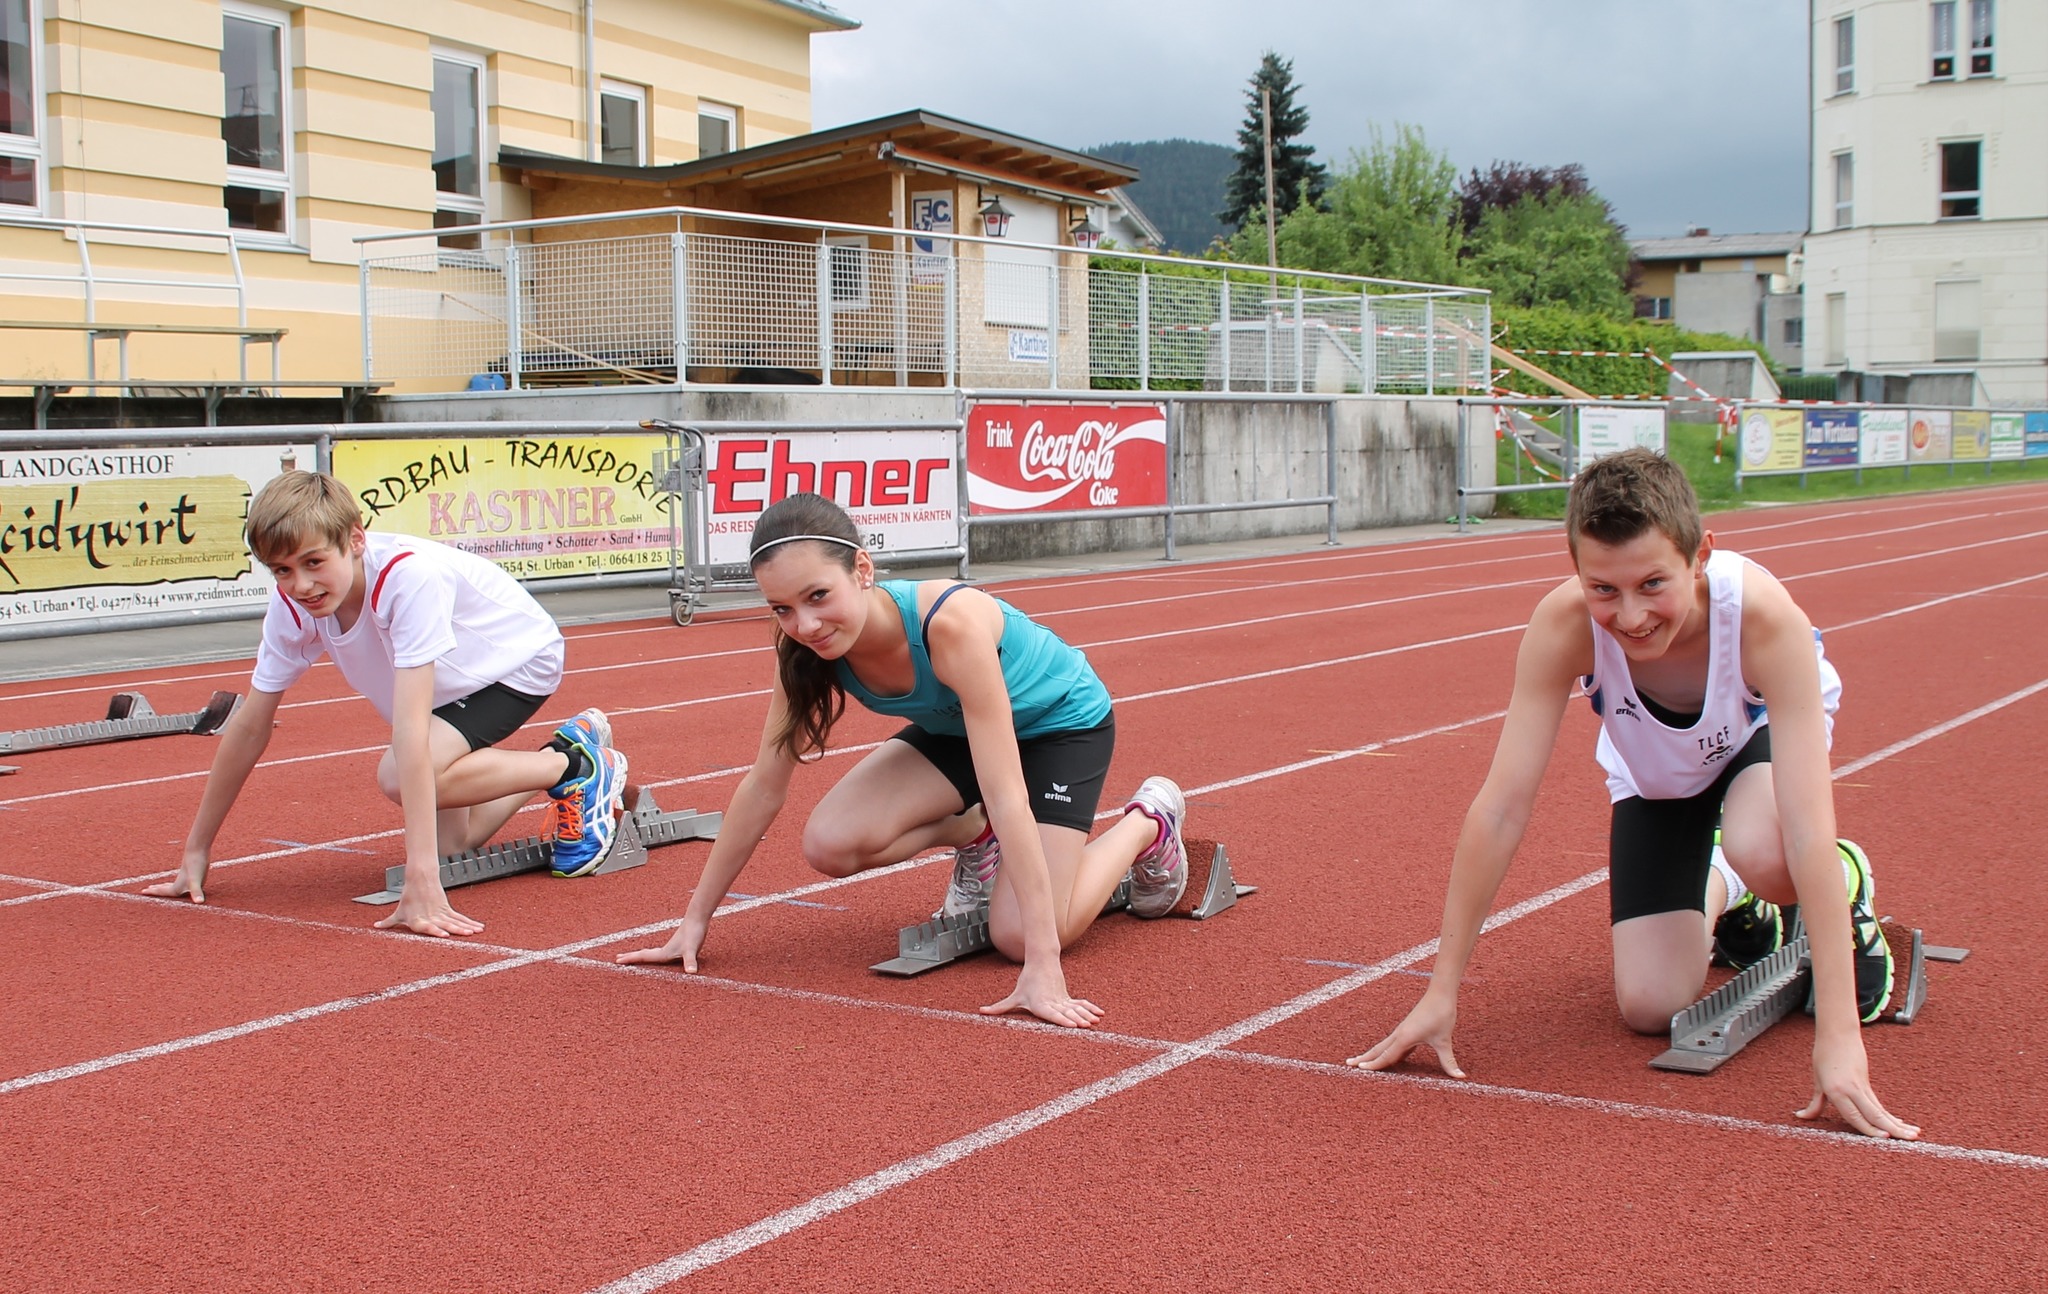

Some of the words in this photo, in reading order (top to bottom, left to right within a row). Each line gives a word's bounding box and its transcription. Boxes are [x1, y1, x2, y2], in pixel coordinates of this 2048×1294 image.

[986, 420, 1013, 447] Trink
[1020, 420, 1118, 481] Coca-Cola
[0, 455, 174, 478] LANDGASTHOF
[1089, 481, 1119, 506] Coke
[427, 485, 617, 535] KASTNER
[620, 514, 643, 524] GmbH
[708, 521, 727, 534] DAS
[730, 520, 758, 533] REIS
[901, 511, 911, 523] IN
[913, 508, 952, 521] KÄRNTEN
[457, 538, 544, 554] Steinschlichtung
[556, 534, 598, 548] Schotter
[610, 532, 634, 545] Sand
[645, 530, 672, 543] Humu
[133, 556, 148, 567] der
[150, 551, 235, 566] Feinschmeckerwirt
[526, 559, 541, 572] St.
[544, 557, 575, 570] Urban
[609, 552, 648, 565] 0664/18
[651, 550, 663, 562] 25
[15, 601, 30, 615] St.
[33, 599, 69, 613] Urban
[77, 596, 99, 611] Tel.
[101, 592, 159, 610] 04277/8244
[168, 585, 268, 602] www.reidnwirt.com
[1698, 725, 1730, 750] TLCF
[1044, 792, 1072, 803] erima
